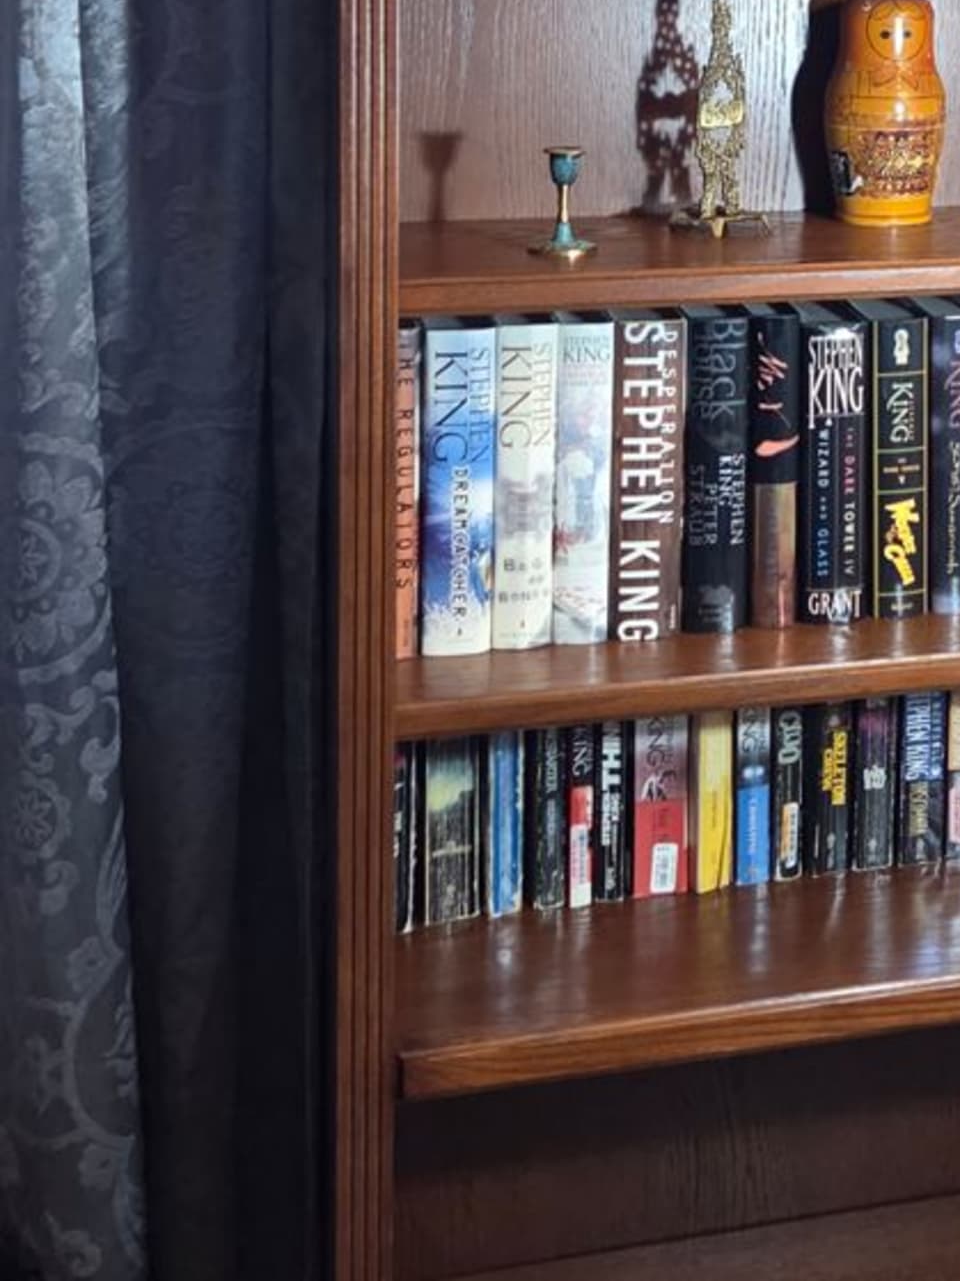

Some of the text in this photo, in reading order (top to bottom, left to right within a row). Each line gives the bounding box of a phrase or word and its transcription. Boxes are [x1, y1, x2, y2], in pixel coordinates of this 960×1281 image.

[562, 347, 610, 363] KING
[709, 319, 747, 423] Black
[434, 351, 468, 462] KING
[471, 349, 490, 464] STEPHEN
[501, 346, 533, 448] KING
[658, 326, 678, 524] DESPERATION
[808, 364, 865, 429] KING
[886, 382, 914, 443] KING
[617, 321, 665, 643] STEPHEN KING
[718, 455, 733, 507] KING
[817, 428, 829, 487] WIZARD
[396, 409, 414, 590] REGULATORS
[689, 464, 704, 546] STRAUB
[703, 483, 718, 545] PETER
[729, 454, 745, 545] STEPHEN
[844, 503, 856, 553] TOWER
[450, 468, 468, 622] DREAMCATCHER
[816, 527, 829, 578] GLASS
[807, 590, 862, 620] GRANT
[905, 743, 930, 781] KING
